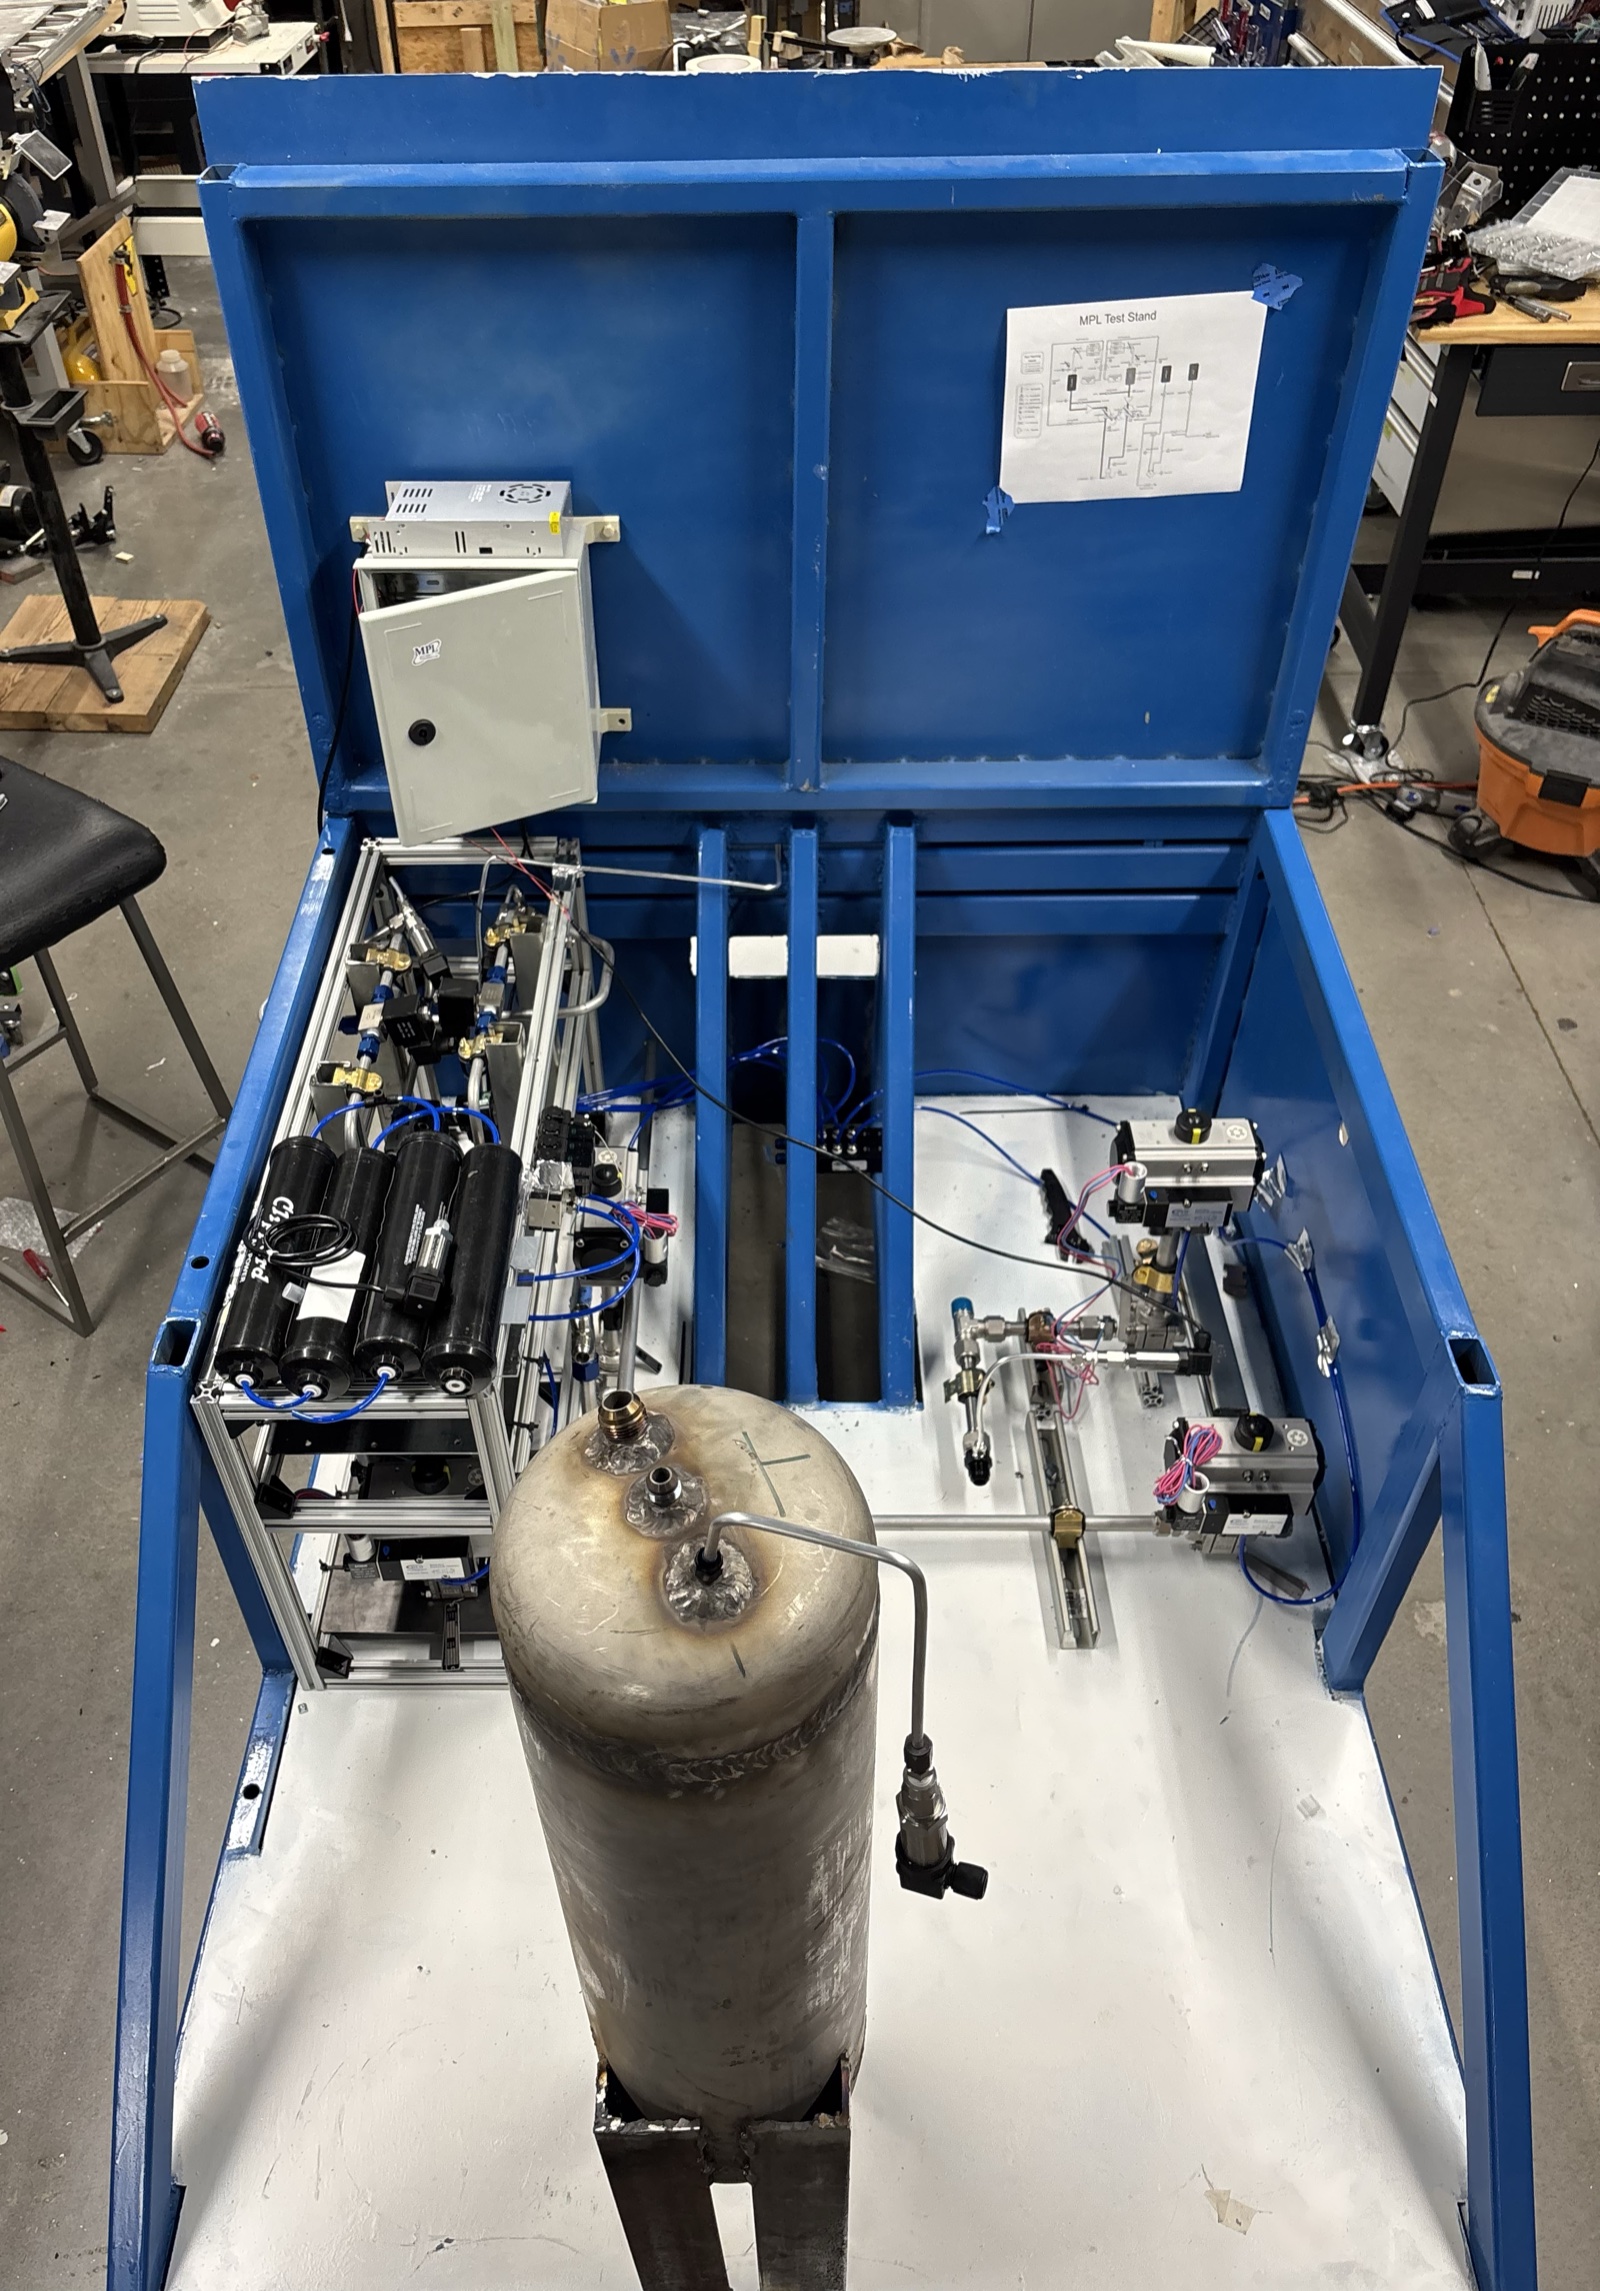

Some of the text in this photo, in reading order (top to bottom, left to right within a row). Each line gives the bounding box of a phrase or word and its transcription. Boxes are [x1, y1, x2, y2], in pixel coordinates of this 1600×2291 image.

[1079, 310, 1157, 326] MPL Test Stand
[251, 1196, 294, 1284] Clird
